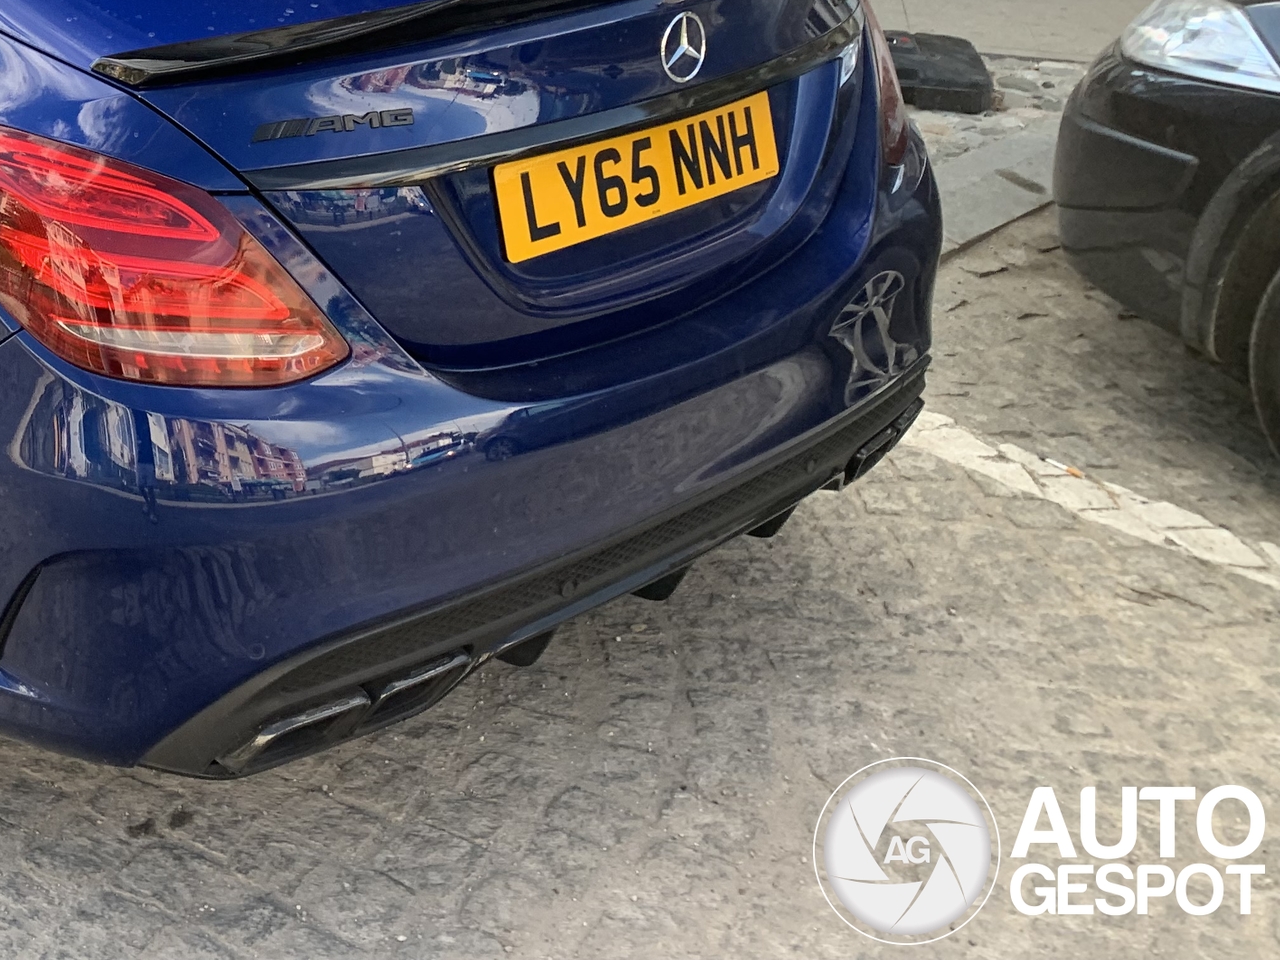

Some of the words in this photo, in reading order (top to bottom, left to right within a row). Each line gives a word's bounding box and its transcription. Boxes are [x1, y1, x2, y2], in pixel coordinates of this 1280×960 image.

[304, 108, 415, 136] AMG
[520, 135, 661, 243] LY65
[668, 106, 761, 196] NNH
